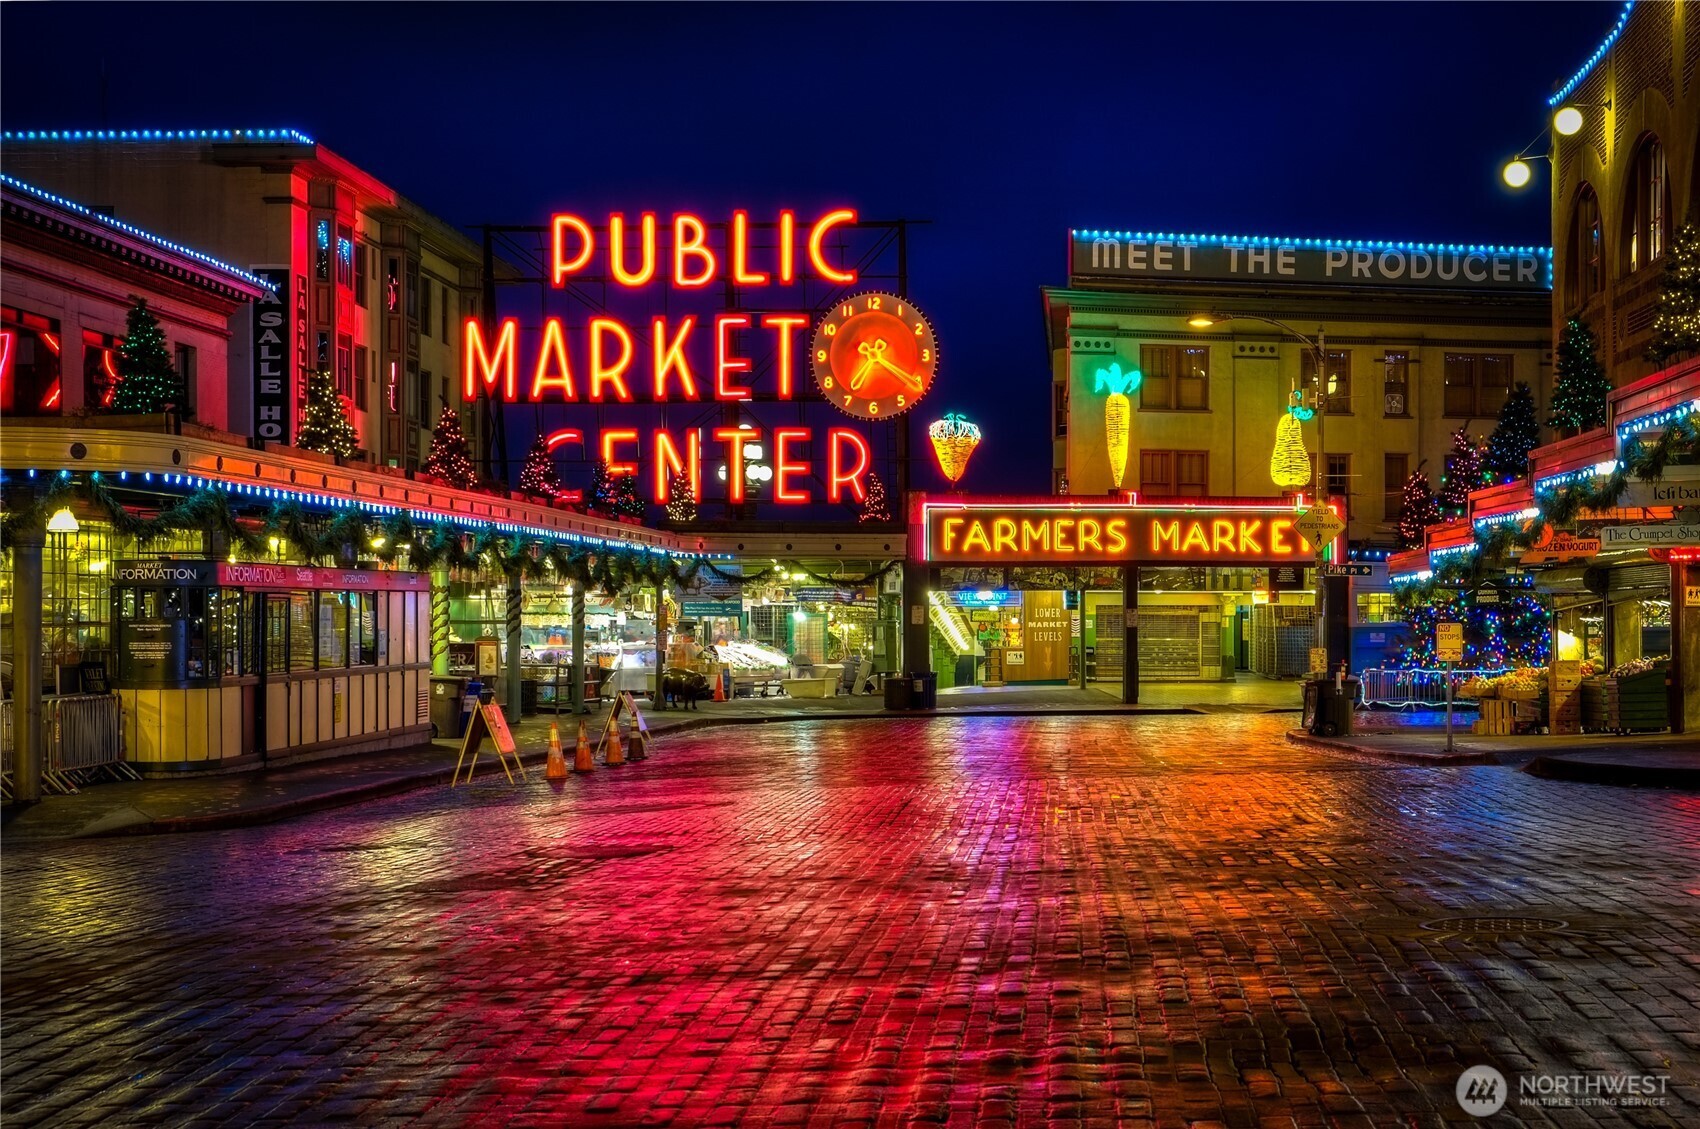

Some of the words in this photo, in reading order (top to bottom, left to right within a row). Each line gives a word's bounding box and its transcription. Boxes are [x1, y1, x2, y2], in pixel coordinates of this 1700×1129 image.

[552, 209, 858, 288] PUBLIC
[1092, 237, 1198, 272] MEET
[1223, 241, 1296, 275] THE
[1326, 246, 1538, 283] PRODUCER
[258, 273, 282, 304] LA
[867, 297, 881, 310] 12
[898, 304, 903, 316] 1
[843, 305, 853, 317] 11
[824, 323, 836, 336] 10
[915, 323, 923, 335] 2
[258, 312, 283, 394] SALLE
[298, 319, 306, 399] SALLE
[462, 314, 810, 402] MARKET
[817, 350, 827, 362] 9
[922, 349, 930, 362] 3
[824, 376, 833, 389] 8
[844, 395, 852, 406] 7
[897, 395, 905, 406] 5
[869, 402, 878, 414] 6
[258, 406, 282, 443] HO
[1679, 485, 1700, 500] ba
[943, 517, 1127, 553] FARMERS
[1606, 527, 1627, 542] The
[1629, 526, 1674, 542] Crumpet
[1677, 525, 1700, 540] Sho
[1532, 543, 1566, 552] OZEN
[1567, 541, 1598, 551] YOGURT
[226, 566, 276, 583] INFORMATION
[1328, 565, 1347, 575] Pike
[958, 592, 1008, 601] VIEWINT
[1035, 608, 1061, 618] LOWER
[1034, 631, 1063, 642] LEVELS
